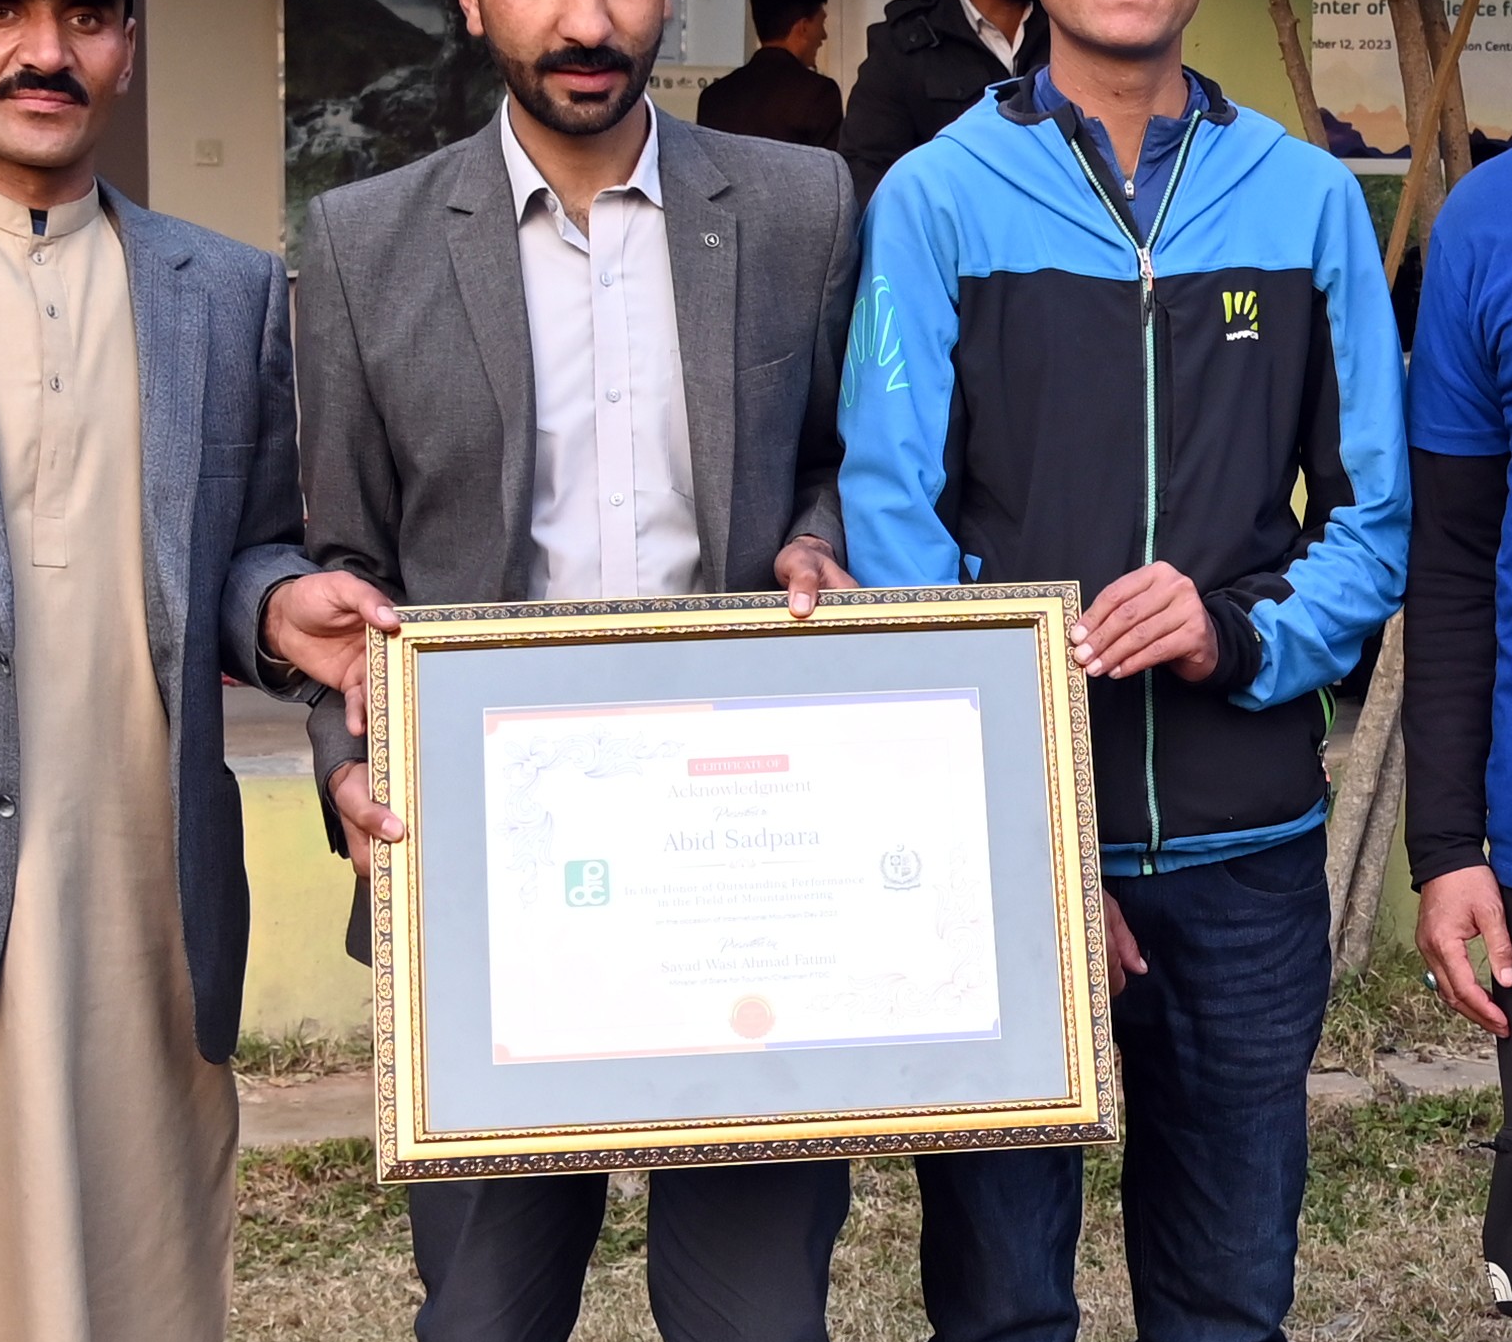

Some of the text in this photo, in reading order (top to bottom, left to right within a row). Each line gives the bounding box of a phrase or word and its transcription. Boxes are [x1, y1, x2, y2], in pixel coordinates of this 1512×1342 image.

[1312, 1, 1358, 16] enter
[1366, 0, 1387, 15] of
[1339, 40, 1355, 52] 12,
[1359, 39, 1392, 50] 2023
[694, 759, 783, 772] CERTIFICATE OF
[667, 779, 812, 799] Acknowledgment
[663, 826, 821, 853] Abid Sadpara
[624, 875, 865, 896] In the Honor of Outstanding Performance
[657, 890, 835, 908] in the Field of Mountaineering
[660, 952, 837, 974] Sayad Wasi Ahmad Fatimi
